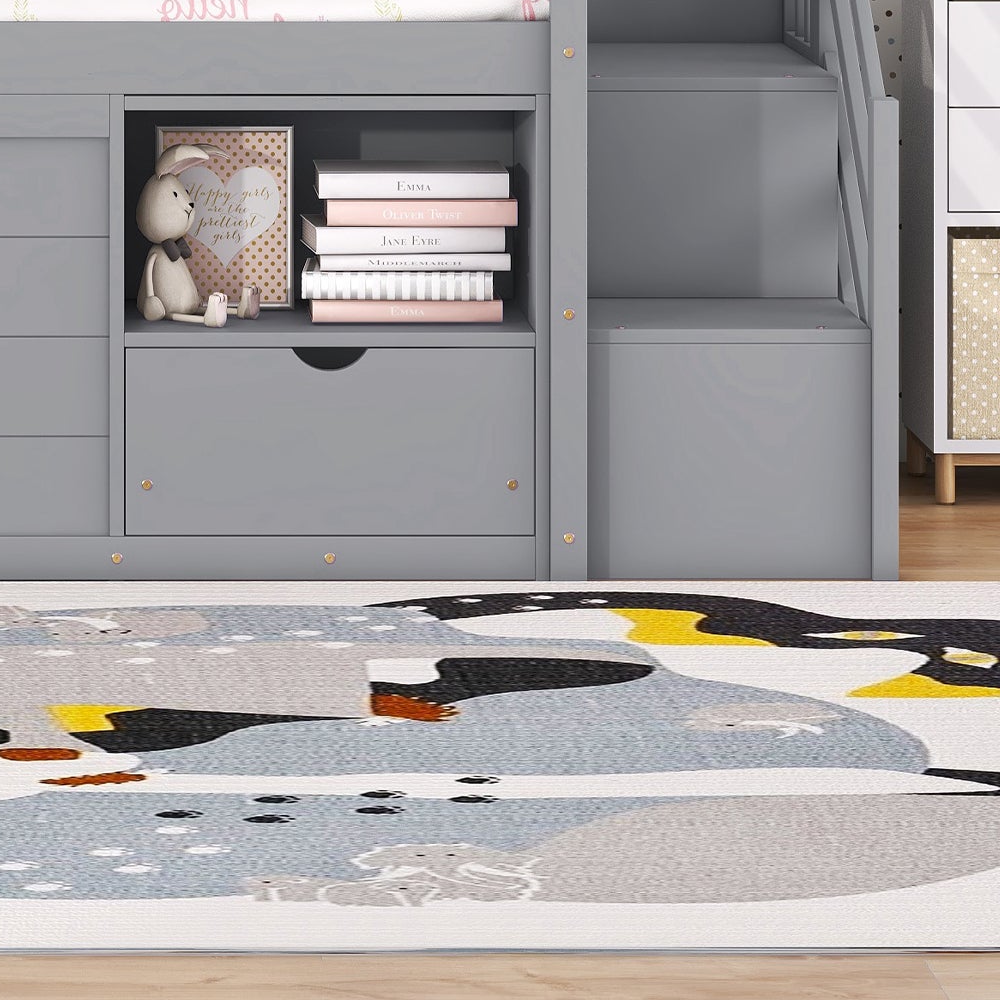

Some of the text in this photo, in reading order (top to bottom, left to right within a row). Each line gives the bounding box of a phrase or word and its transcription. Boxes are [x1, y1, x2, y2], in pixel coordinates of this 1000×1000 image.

[396, 181, 431, 192] EMMA
[240, 186, 270, 203] girls
[211, 230, 242, 246] girls
[380, 235, 441, 247] JANE EYRE
